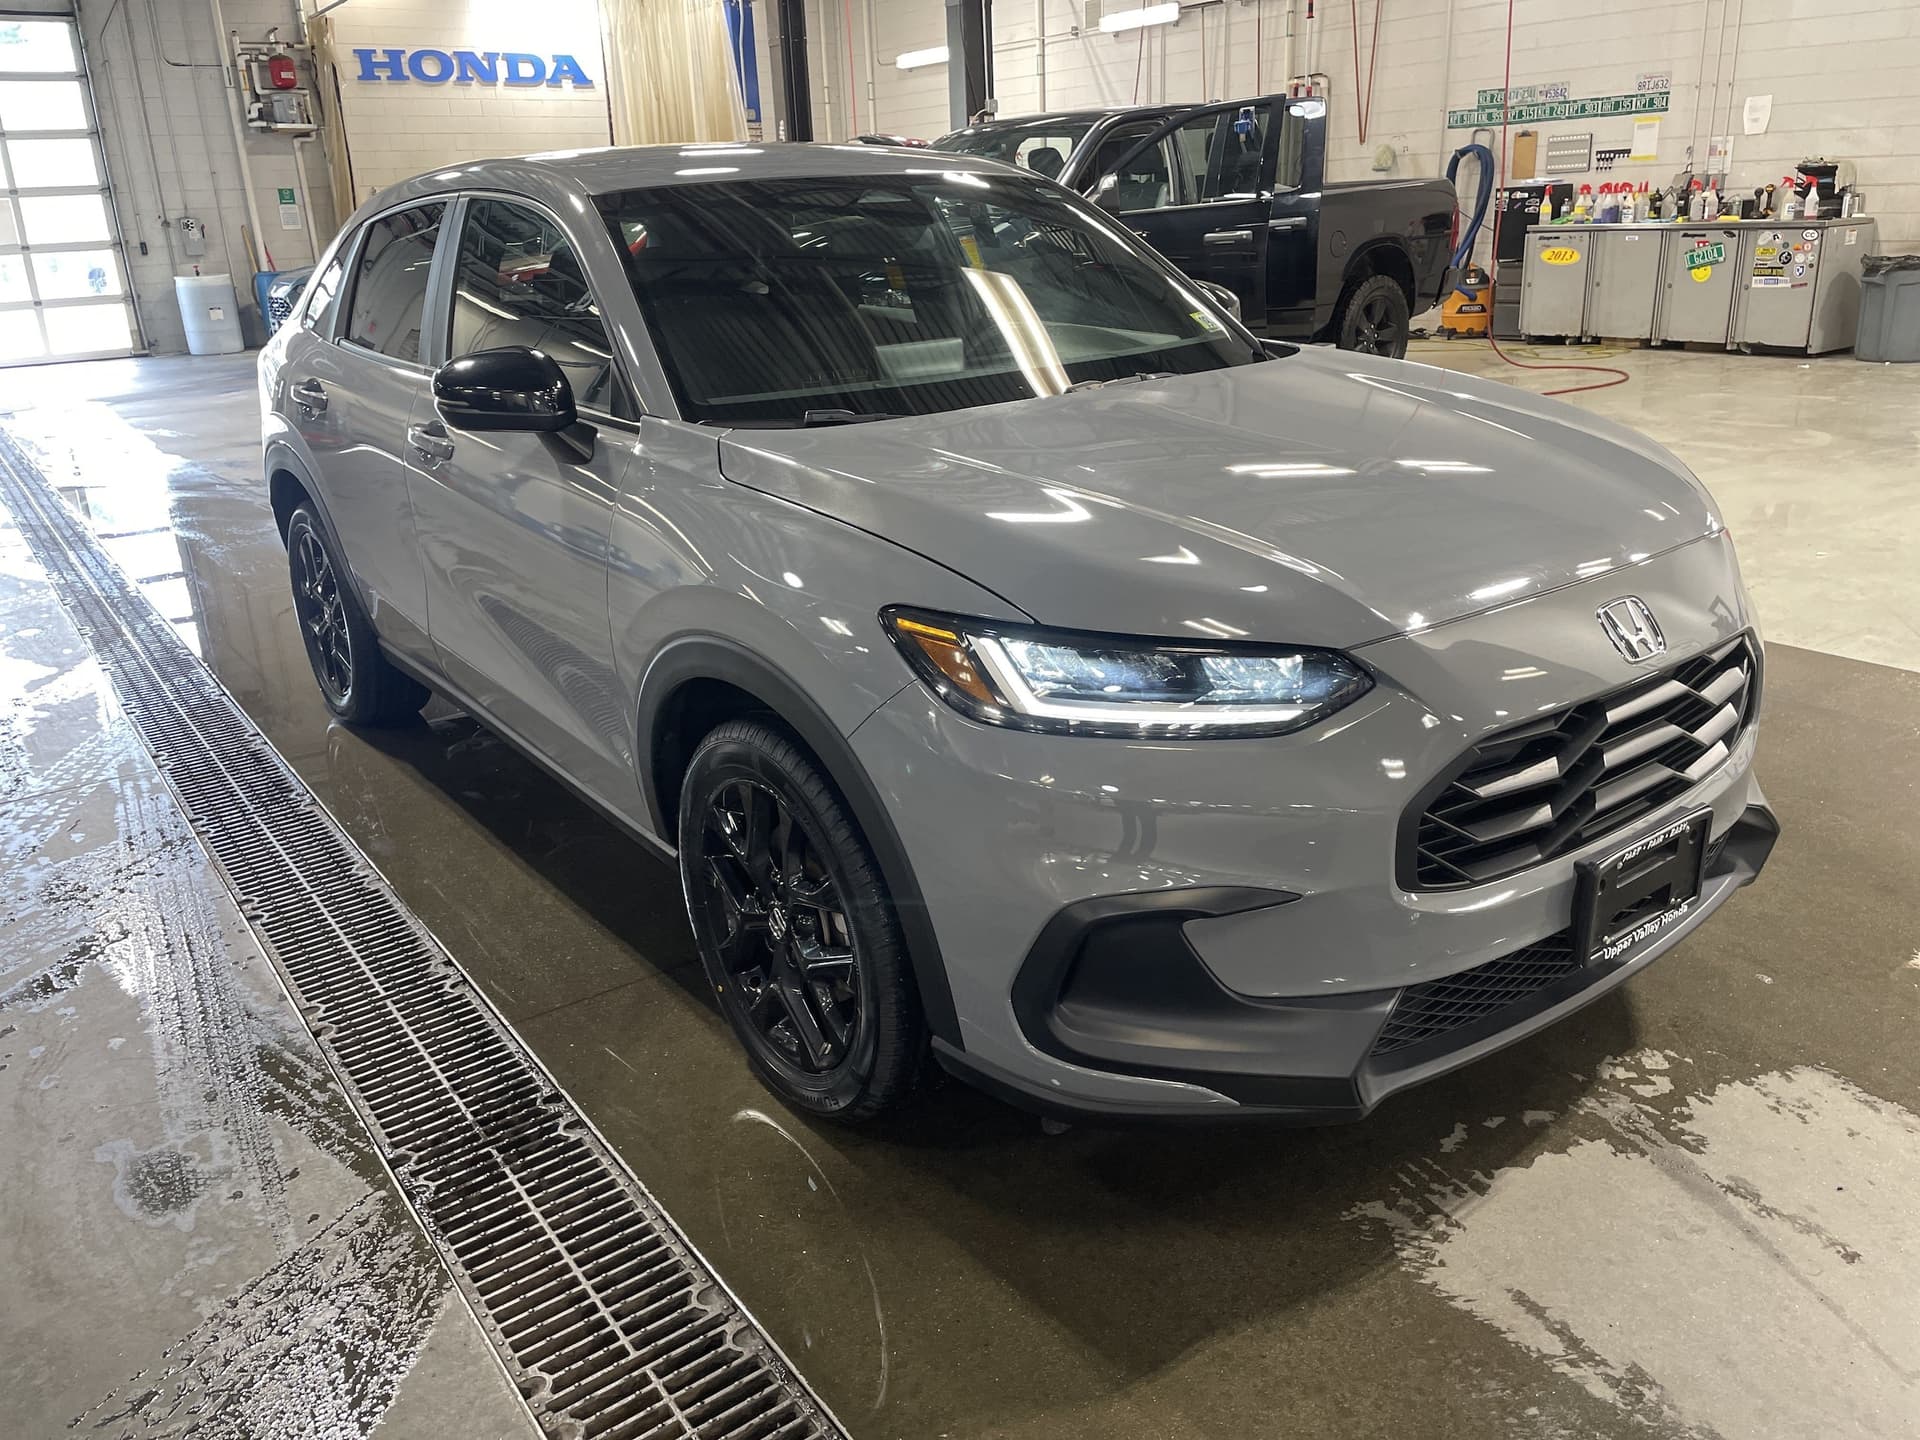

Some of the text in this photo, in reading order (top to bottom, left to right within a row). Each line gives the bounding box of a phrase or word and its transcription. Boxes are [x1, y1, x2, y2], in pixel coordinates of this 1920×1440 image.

[353, 48, 595, 89] HONDA
[1547, 250, 1575, 261] 2013
[1603, 904, 1689, 960] Upper Valley Honda
